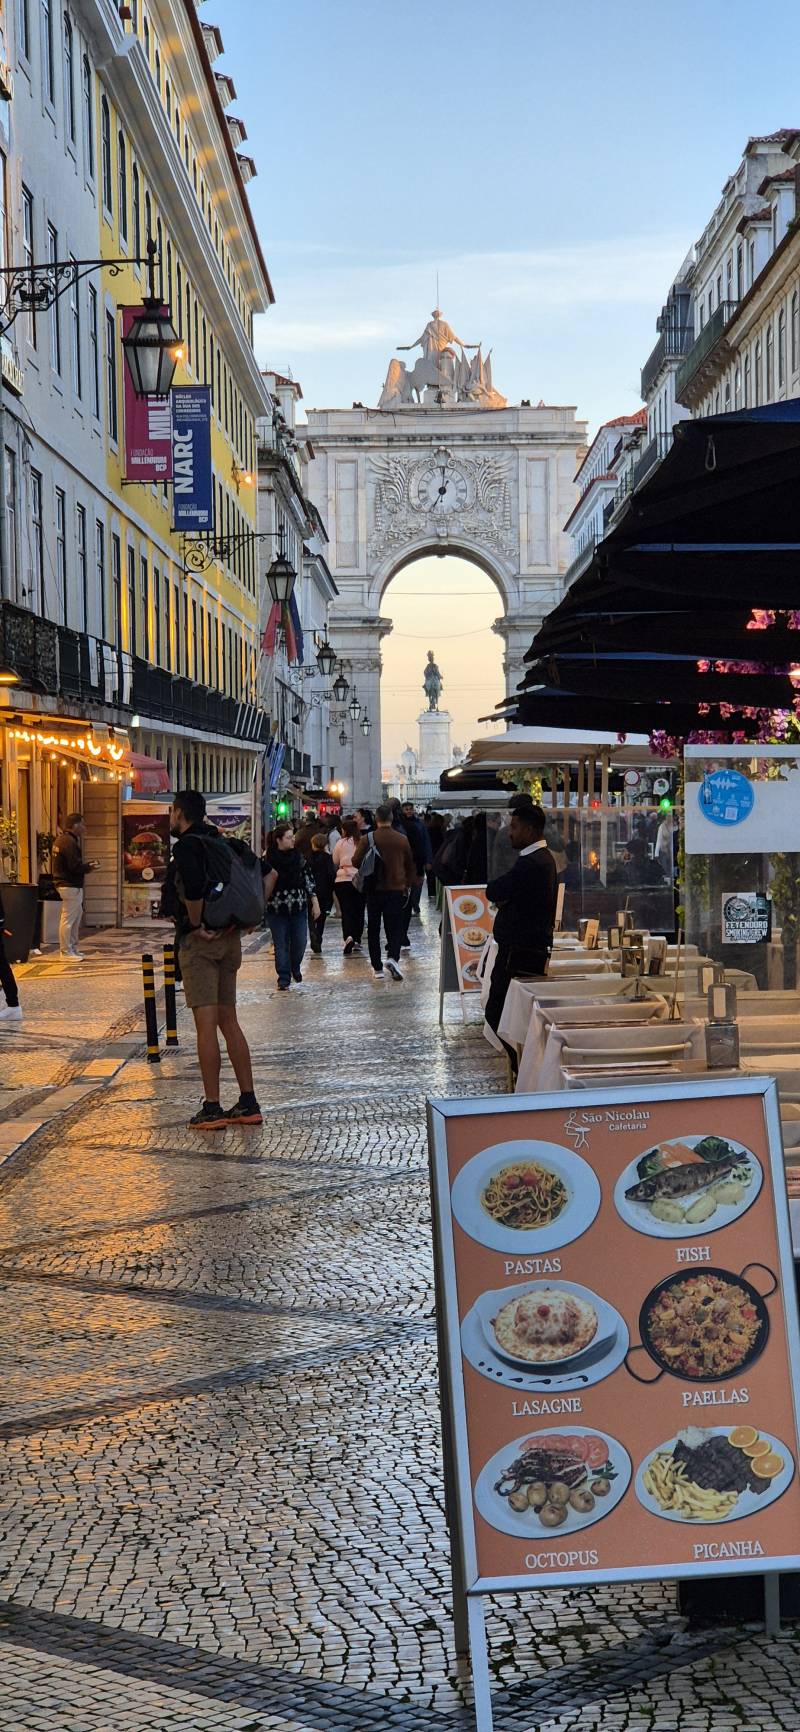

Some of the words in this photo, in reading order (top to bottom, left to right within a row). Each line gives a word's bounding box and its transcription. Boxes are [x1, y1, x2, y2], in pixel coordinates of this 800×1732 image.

[148, 394, 171, 440] MILL
[174, 429, 194, 494] NARC
[582, 1112, 602, 1123] São
[605, 1109, 650, 1121] Nicolau
[609, 1123, 647, 1131] Cafetaria
[676, 1246, 711, 1262] FISH
[504, 1258, 562, 1275] PASTAS
[511, 1397, 583, 1416] LASAGNE
[682, 1388, 750, 1407] PAELLAS
[693, 1540, 765, 1559] PICANHA
[525, 1550, 599, 1569] OCTOPUS
